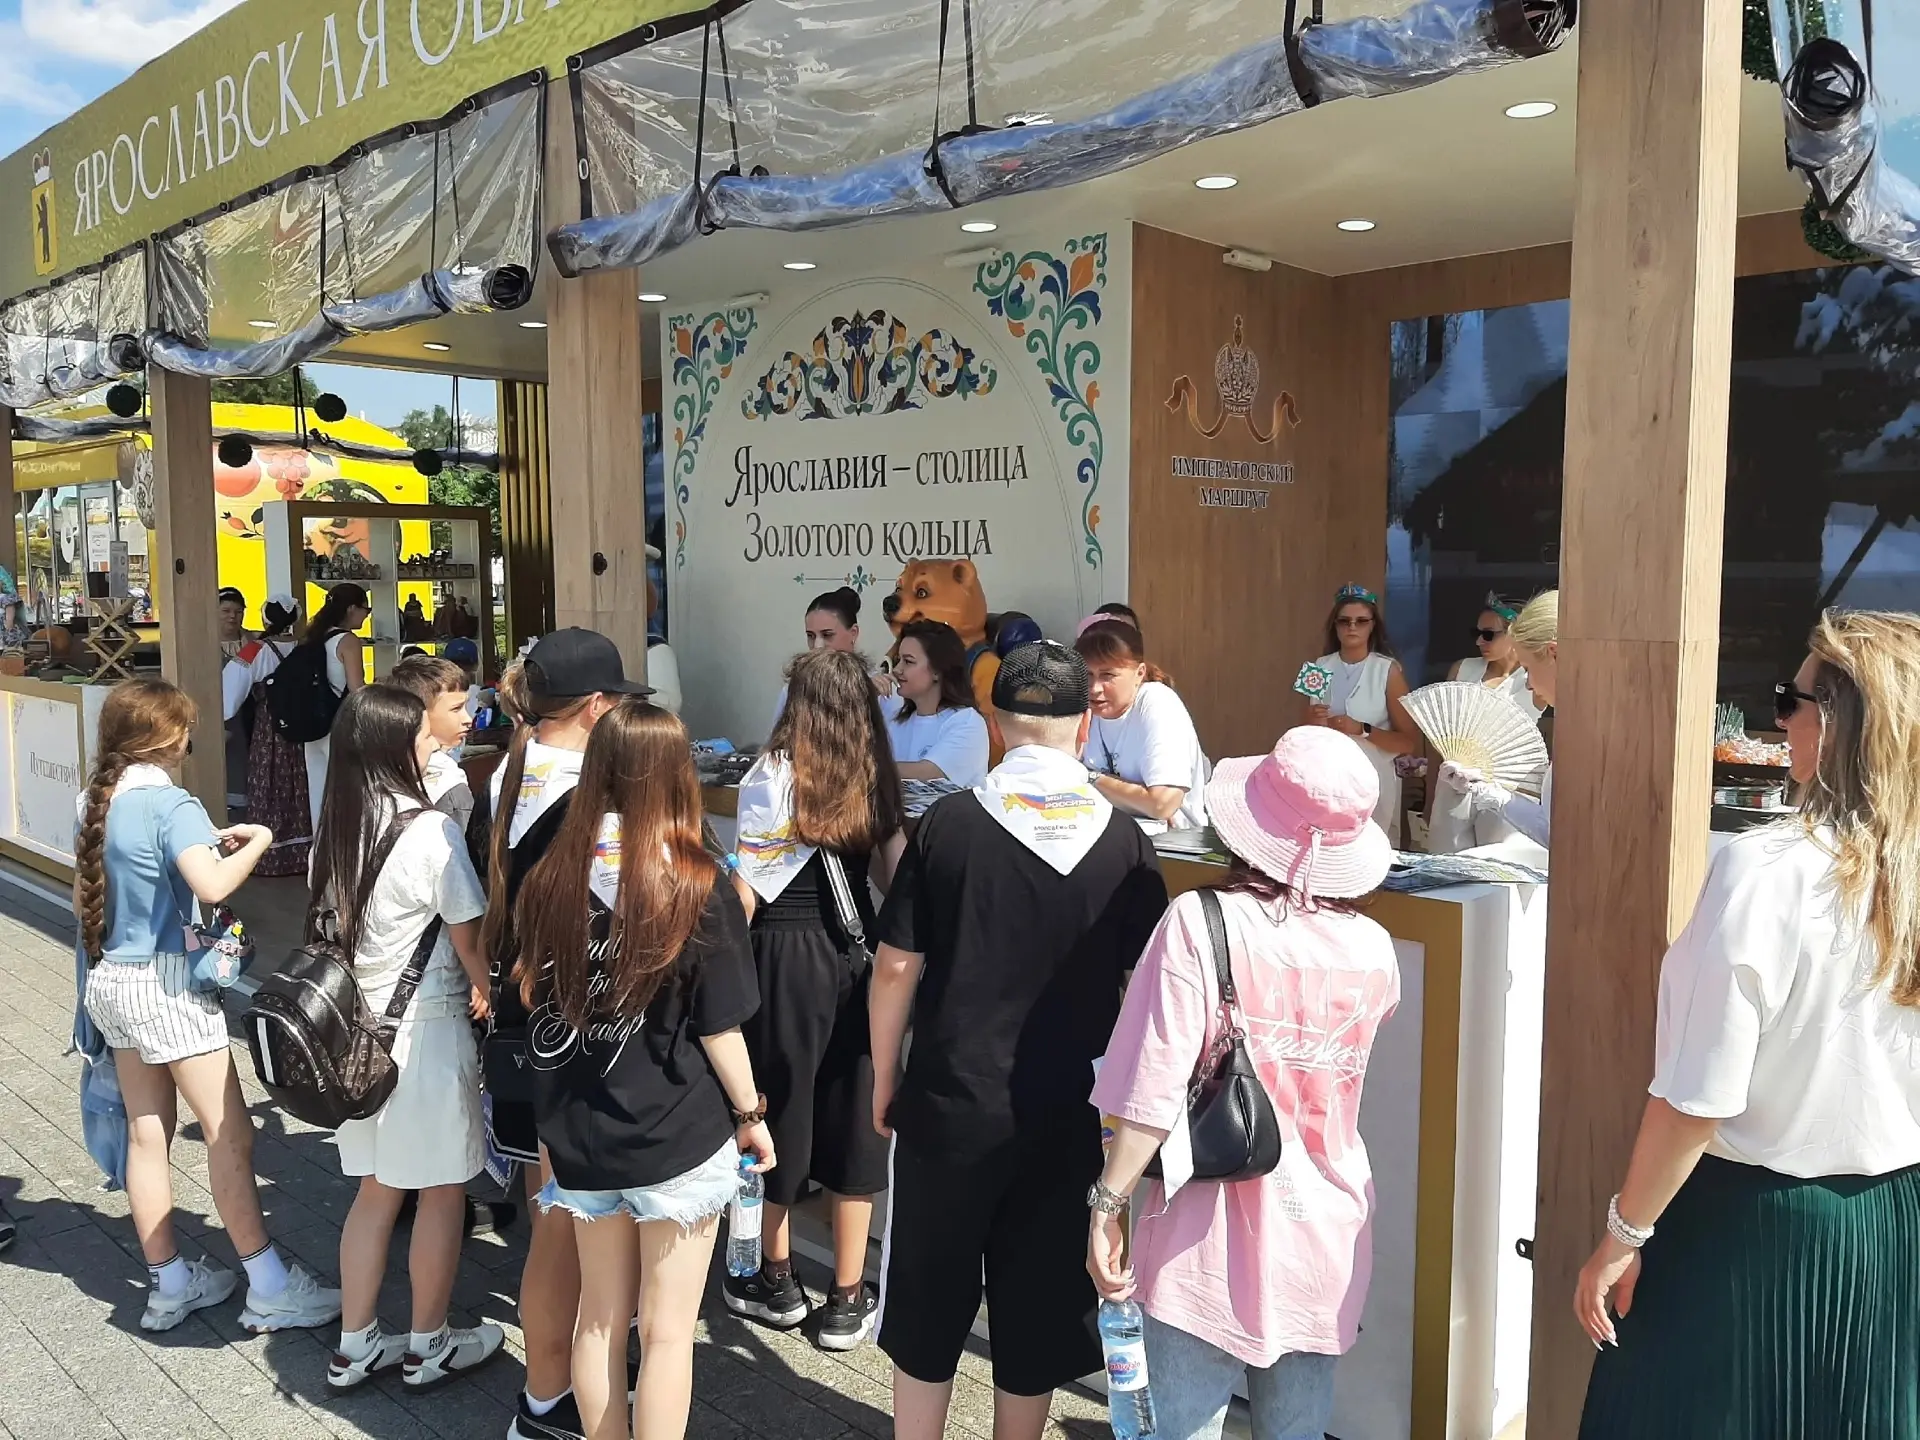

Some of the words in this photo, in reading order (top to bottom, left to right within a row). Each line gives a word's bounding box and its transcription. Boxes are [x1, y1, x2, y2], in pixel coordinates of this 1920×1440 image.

[73, 0, 389, 237] ЯРОСЛАВСКАЯ
[1172, 456, 1294, 483] ИМПЕРАТОРСКИЙ
[1199, 486, 1271, 513] МАРШРУТ
